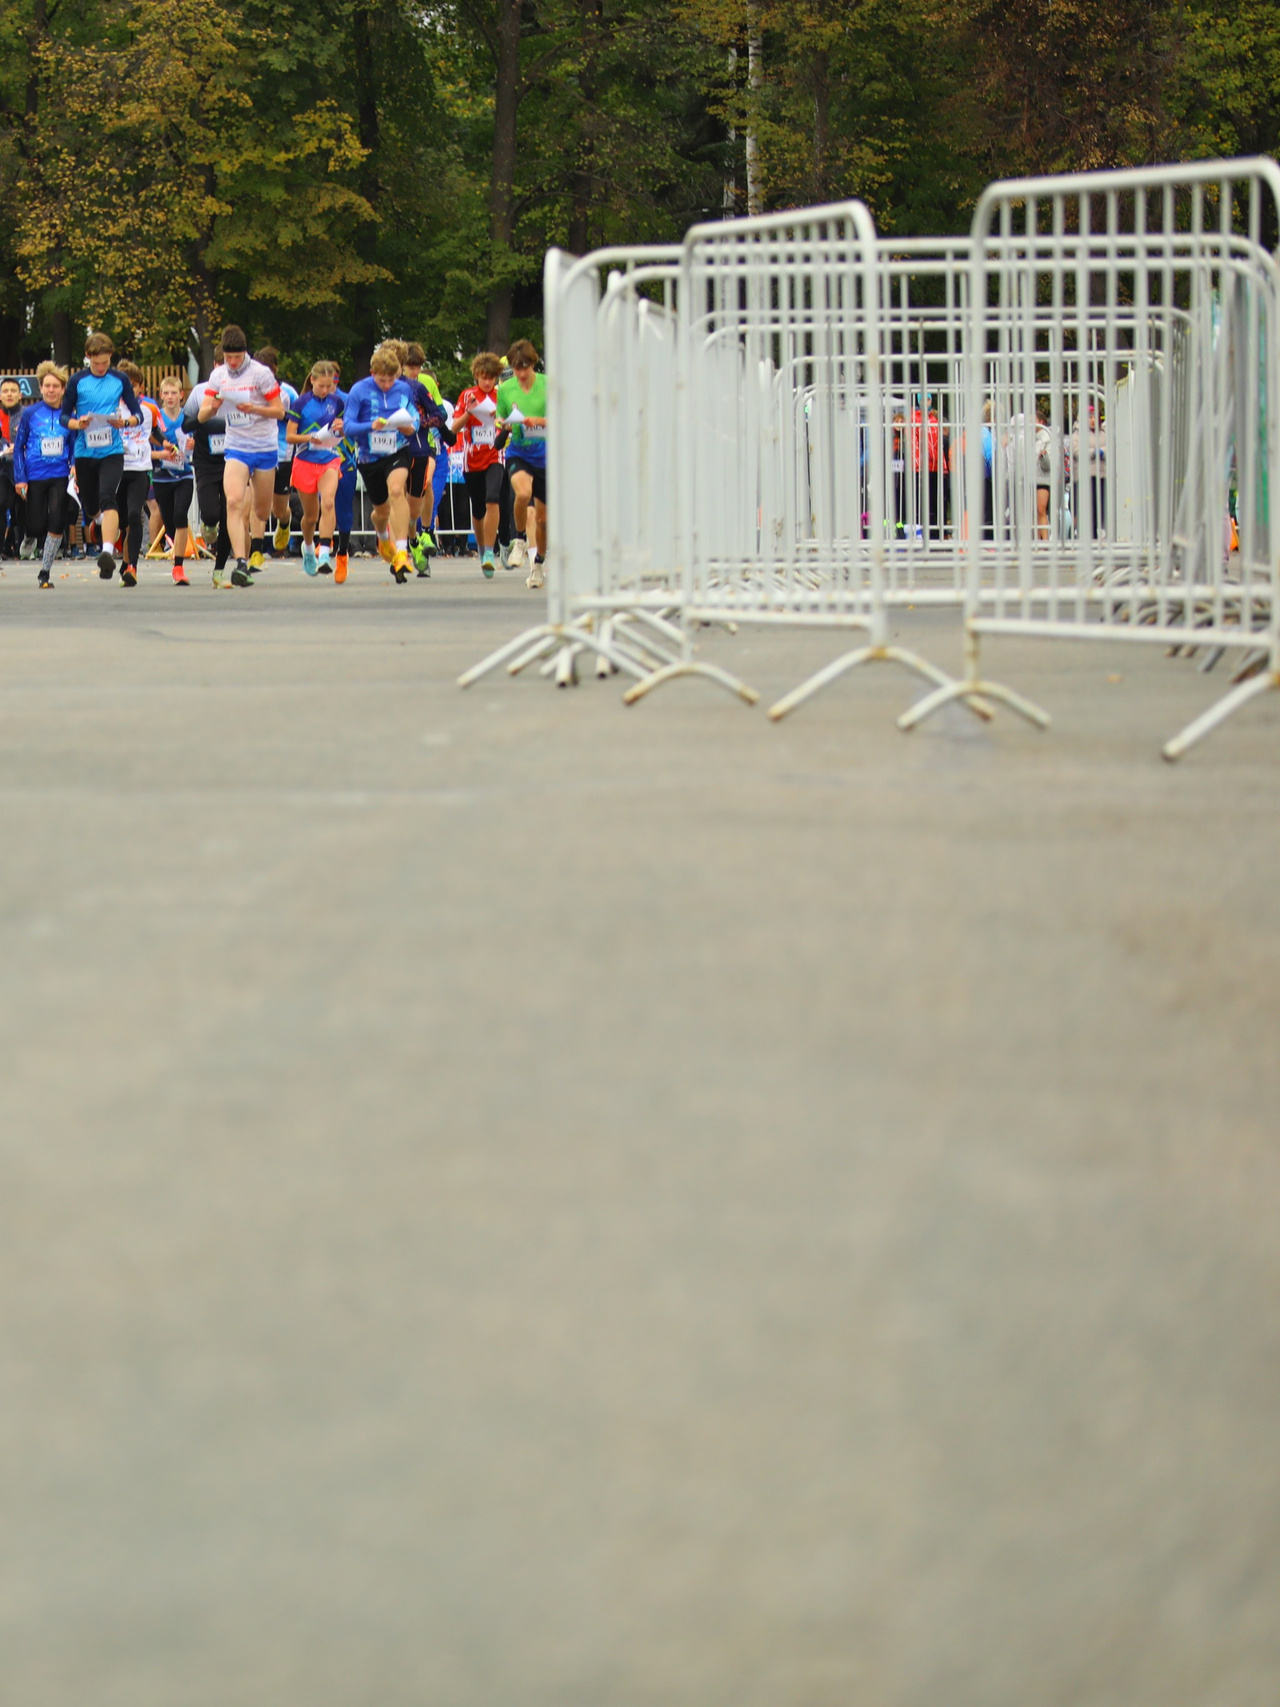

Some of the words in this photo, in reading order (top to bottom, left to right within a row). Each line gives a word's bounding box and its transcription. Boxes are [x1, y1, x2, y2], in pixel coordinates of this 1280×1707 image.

[89, 432, 108, 441] 316.1
[373, 436, 392, 446] 339.1
[42, 441, 60, 450] 357.1
[213, 438, 225, 447] 337
